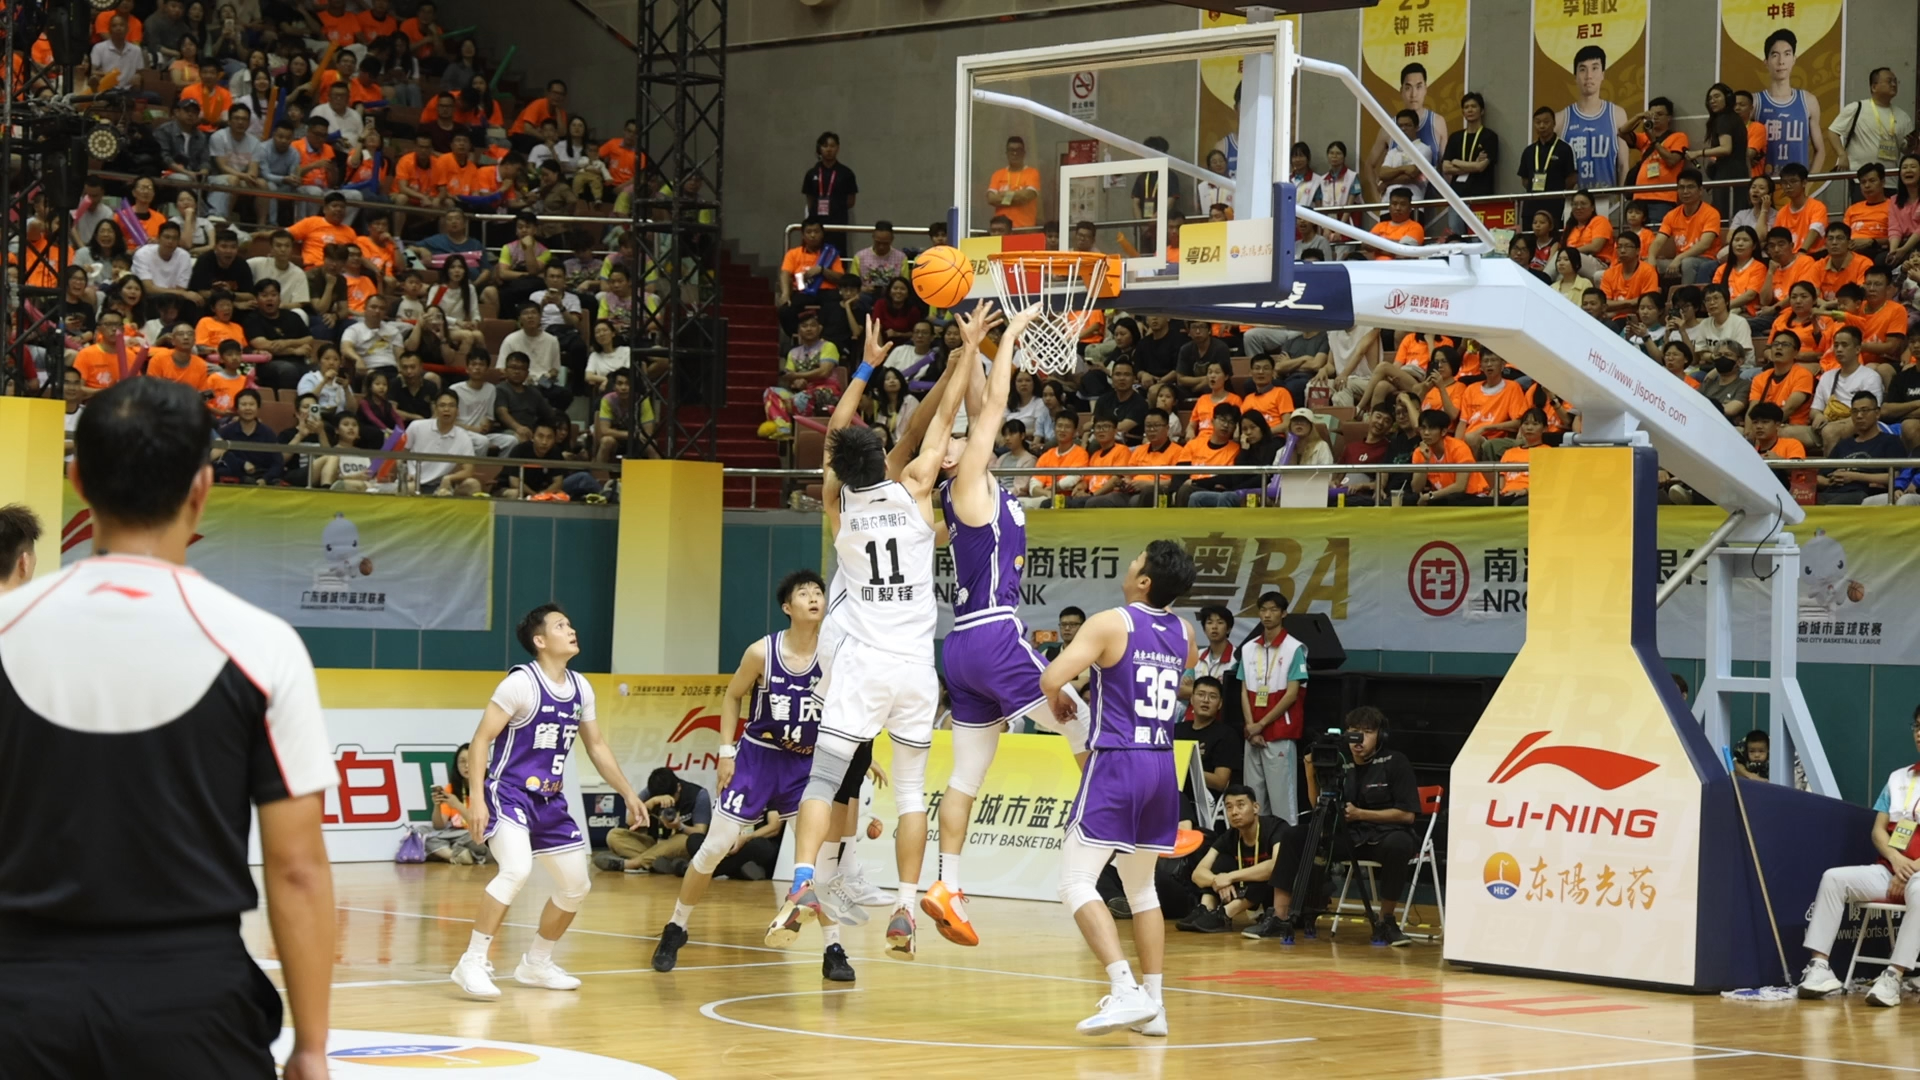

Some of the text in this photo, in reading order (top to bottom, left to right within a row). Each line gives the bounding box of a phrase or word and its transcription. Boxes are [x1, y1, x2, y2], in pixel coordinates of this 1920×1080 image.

[1767, 2, 1795, 19] 中锋
[1576, 23, 1603, 39] 后卫
[1404, 40, 1429, 57] 前锋
[1778, 143, 1788, 160] 11
[1581, 161, 1594, 178] 31
[1185, 245, 1221, 264] 粤BA
[1410, 294, 1450, 310] 金陵体育
[850, 512, 907, 532] 南海农商银行
[865, 537, 904, 586] 11
[1484, 547, 1528, 583] 南
[861, 585, 914, 602] 何毅锋
[1134, 665, 1178, 722] 36
[782, 724, 802, 743] 14
[551, 754, 565, 776] 5
[723, 790, 745, 814] 14
[514, 807, 527, 825] 5
[1486, 799, 1659, 839] LI-NING
[970, 832, 999, 846] CITY
[1493, 885, 1510, 897] HEC
